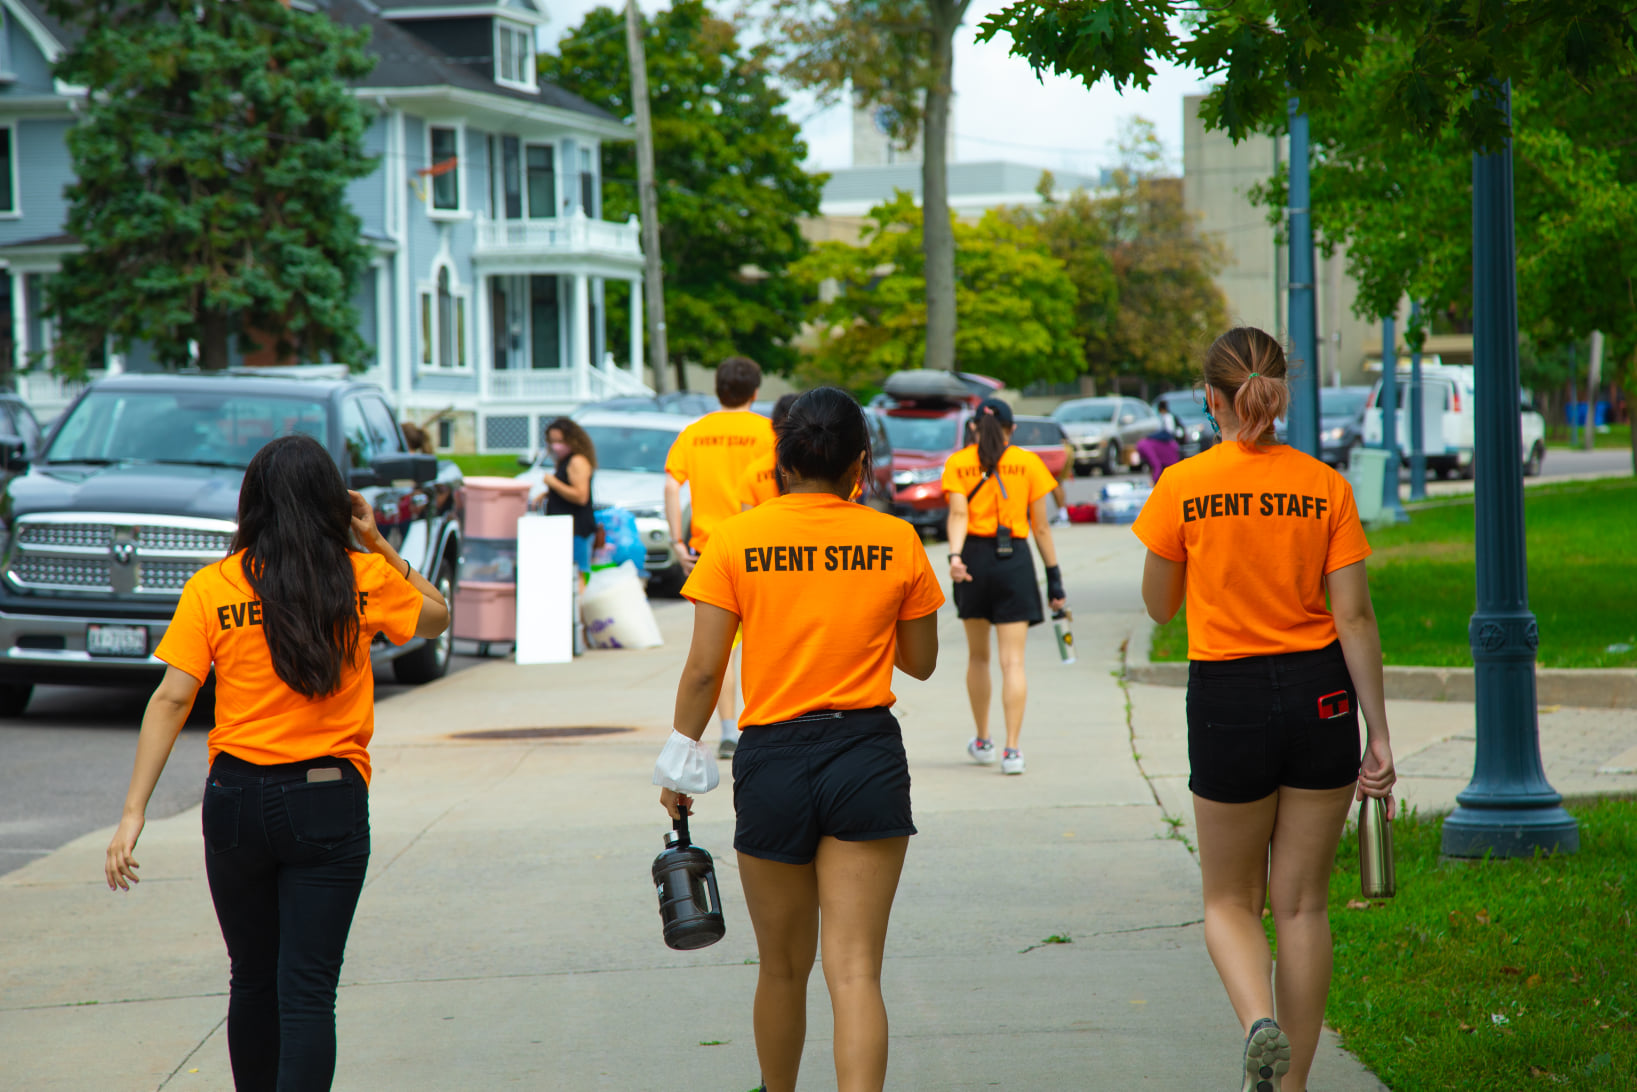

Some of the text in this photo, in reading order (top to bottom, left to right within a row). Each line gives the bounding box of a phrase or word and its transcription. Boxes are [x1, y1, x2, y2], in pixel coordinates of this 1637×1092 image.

[693, 435, 757, 447] EVENT STAFF
[756, 469, 776, 483] EVE
[957, 464, 1026, 479] EVE TAFF
[1183, 492, 1328, 523] EVENT STAFF
[744, 545, 894, 572] EVENT STAFF
[217, 600, 263, 631] EVE
